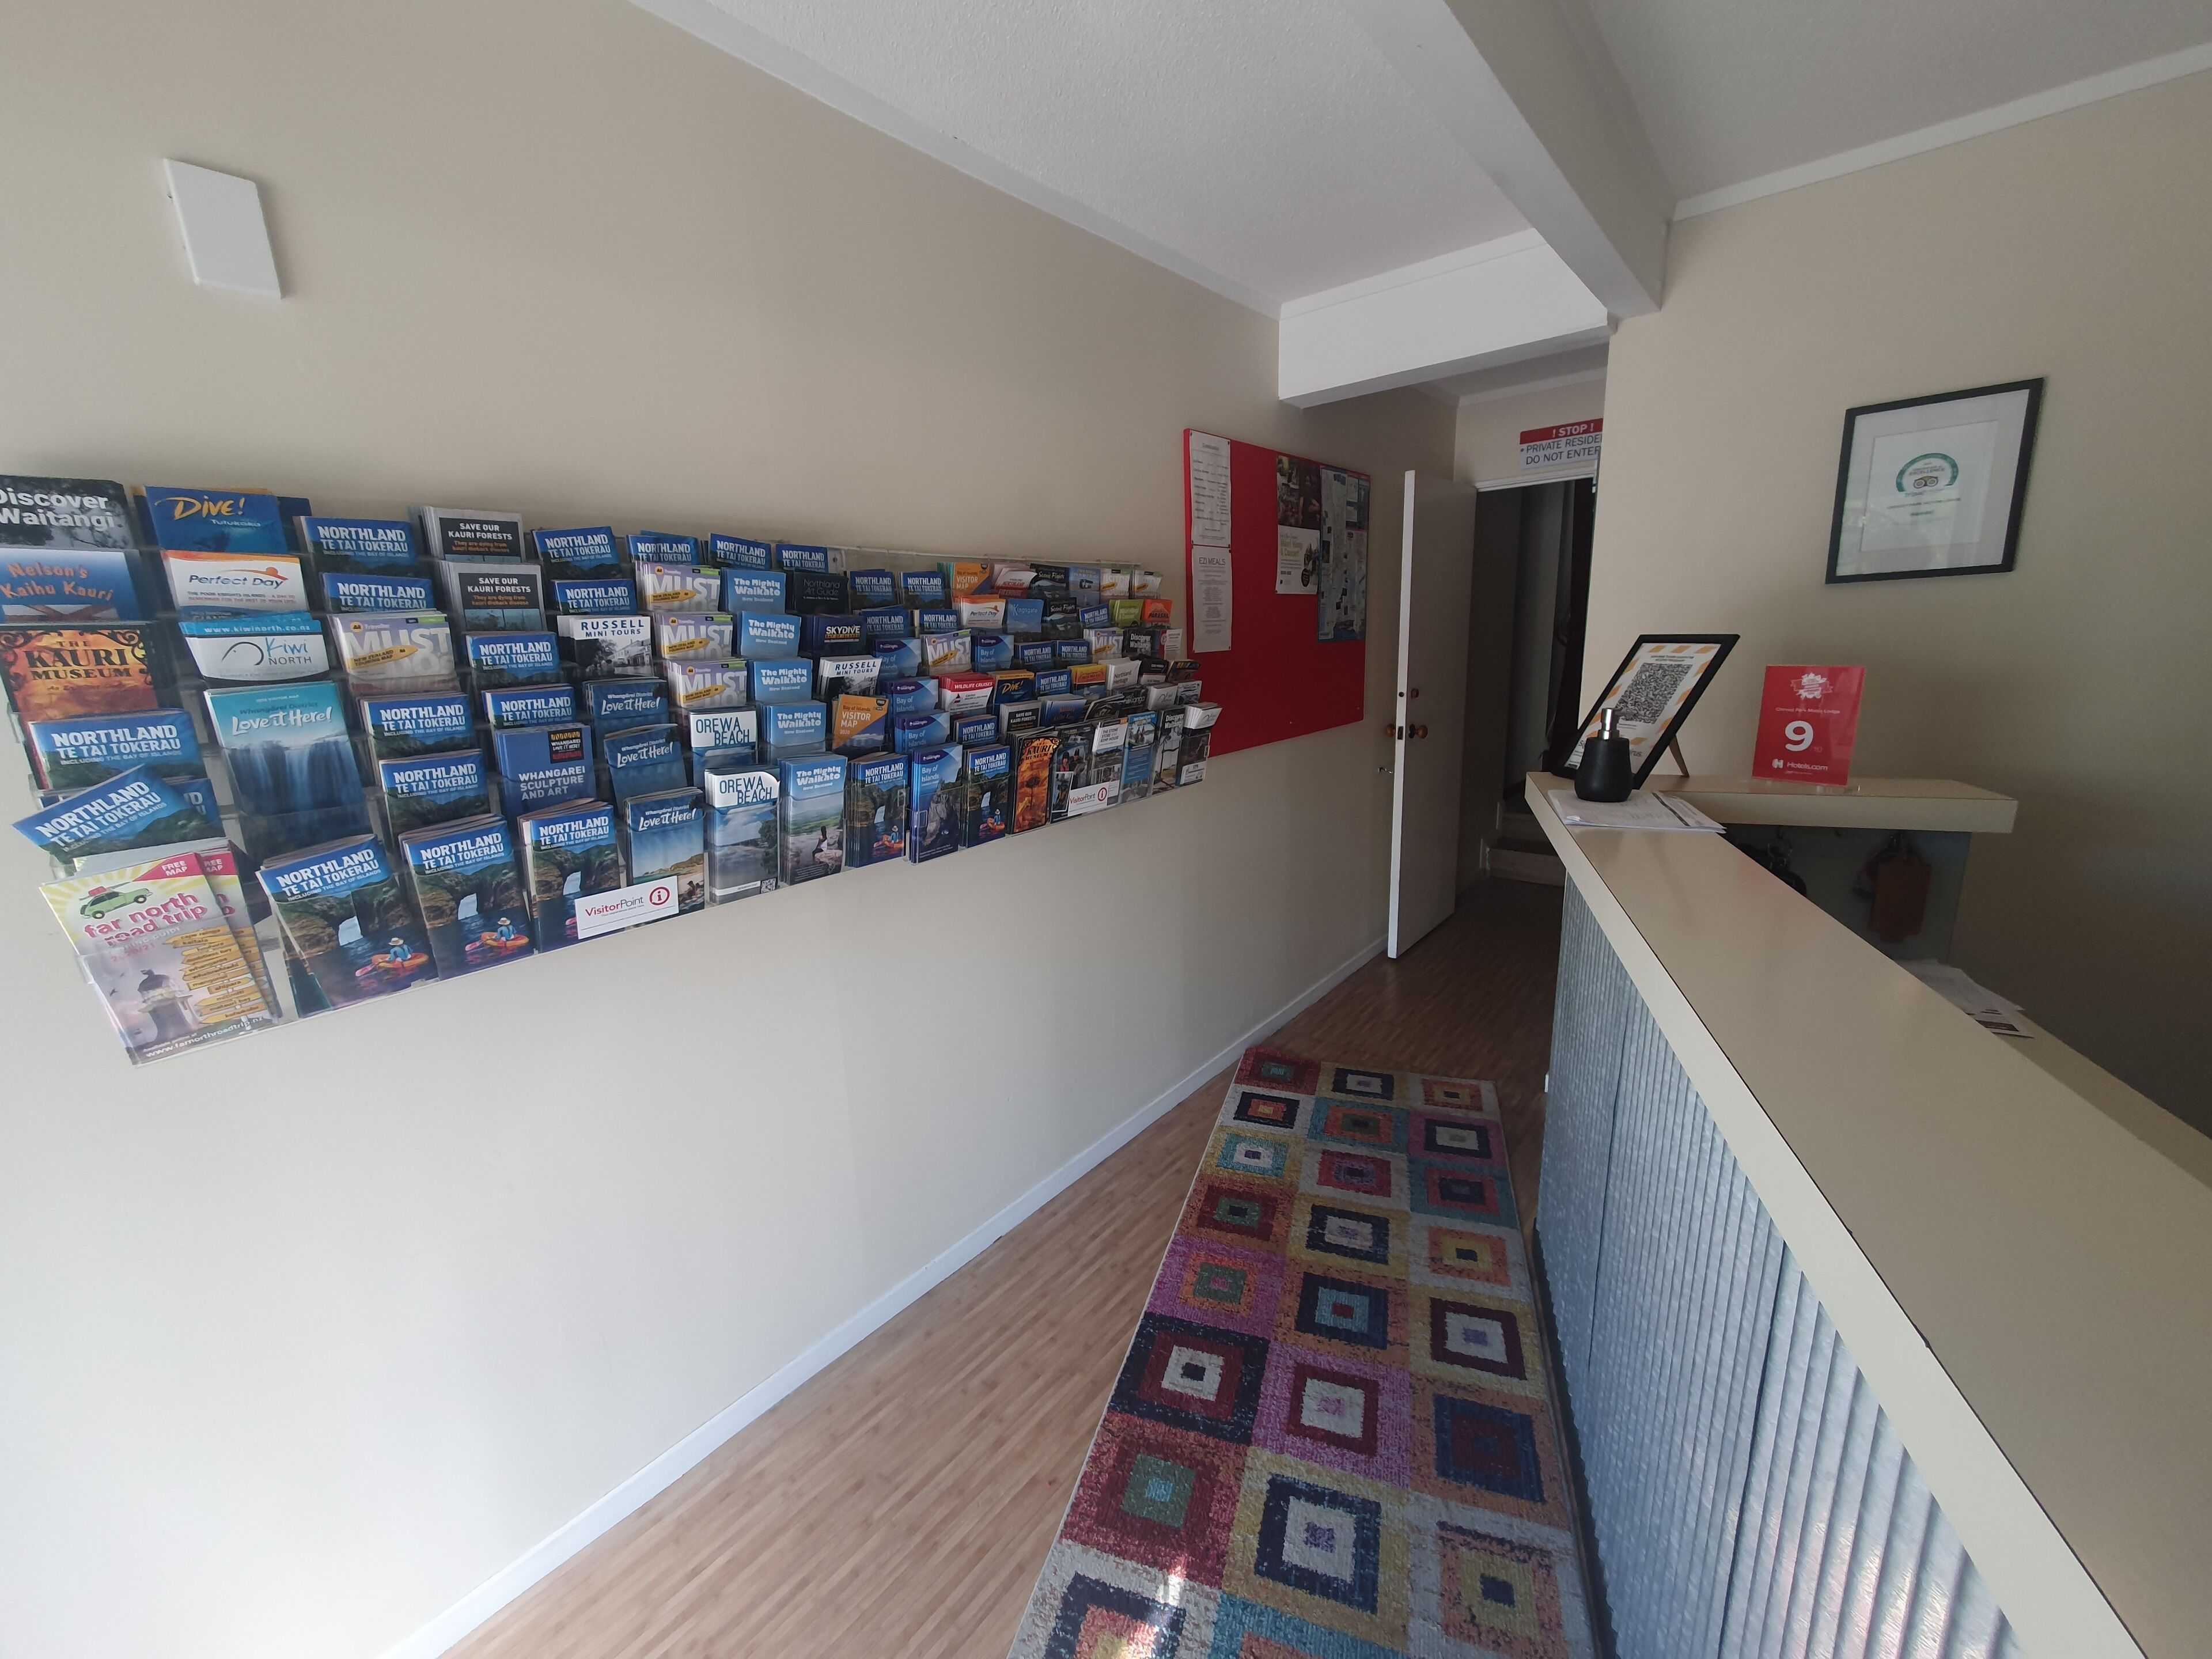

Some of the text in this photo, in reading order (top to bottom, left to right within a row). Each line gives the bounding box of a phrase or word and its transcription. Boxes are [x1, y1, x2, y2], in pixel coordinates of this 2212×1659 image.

[1558, 423, 1588, 437] STOP
[1526, 434, 1602, 454] PRIVATE RESIDE
[1526, 445, 1601, 465] DO NOT ENTER
[154, 495, 246, 521] Dive!
[0, 507, 115, 532] Waitangi
[459, 522, 500, 532] SAVE OUR
[317, 525, 407, 542] NORTHLAND
[448, 531, 513, 540] KAURI FORESTS
[320, 539, 408, 552] TE TAI TOKERAU
[544, 534, 608, 549] NORTHLAND
[1199, 556, 1226, 566] EZI MEALS
[7, 561, 89, 579] Nelson's
[189, 574, 284, 589] Perfect Day
[650, 574, 720, 600] MUST
[733, 577, 781, 589] The Mighty
[803, 578, 840, 589] Northland
[956, 575, 979, 584] VISITOR
[956, 582, 969, 590] MAP
[1, 580, 114, 601] Kaihu Kauri
[337, 582, 426, 600] NORTHLAND
[565, 586, 628, 600] NORTHLAND
[734, 585, 781, 597] Waikato
[804, 588, 839, 596] Art Guide
[339, 596, 427, 609] TE TAI TOKERAU
[1013, 604, 1039, 616] Kingsgate
[581, 619, 644, 631] RUSSELL
[748, 619, 795, 632] The Mighty
[825, 624, 861, 634] SKYDIVE
[663, 624, 733, 646] MUST
[749, 627, 795, 639] Waikato
[265, 637, 308, 657] Kiwi
[346, 627, 451, 657] MUST
[479, 642, 551, 656] NORTHLAND
[24, 649, 130, 668] KAURI
[268, 656, 312, 665] NORTH
[835, 661, 877, 671] RUSSELL
[30, 668, 132, 680] MUSEUM
[761, 676, 808, 685] Waikato
[778, 668, 807, 678] Mighty
[681, 671, 747, 695] MUST
[501, 696, 571, 712] NORTHLAND
[601, 696, 661, 715] Love it Here!
[896, 697, 907, 705] Bay
[379, 704, 464, 721] NORTHLAND
[794, 711, 821, 721] Mighty
[842, 711, 872, 721] VISITOR
[232, 706, 333, 736] Love it Here!
[382, 716, 466, 732] TE TAI TOKERAU
[696, 717, 741, 733] OREWA
[778, 718, 821, 729] Waikato
[840, 719, 858, 728] MAP
[51, 724, 179, 747] NORTHLAND
[714, 729, 749, 745] BEACH
[1785, 720, 1815, 752] 9
[56, 737, 181, 759] TE TAI TOKERAU
[617, 741, 674, 768] Love it Here!
[1027, 744, 1051, 755] KAURI
[1024, 752, 1048, 761] MUSEUM
[393, 763, 476, 784] NORTHLAND
[518, 766, 586, 782] WHANGAREI
[813, 766, 842, 776] Mighty
[922, 767, 932, 775] Bay
[1787, 762, 1828, 771] Hotels.com
[395, 774, 478, 794] TE TAI TOKERAU
[520, 775, 584, 791] SCULPTURE
[719, 775, 764, 794] OREWA
[796, 773, 841, 786] Waikato
[922, 773, 940, 782] Islands
[521, 786, 569, 801] AND ART
[737, 787, 772, 804] BEACH
[1070, 792, 1096, 804] VisitorPoint
[35, 781, 150, 838] NORTHLAND
[51, 791, 162, 847] TE TAI TOKERAU
[539, 816, 609, 837] NORTHLAND
[638, 808, 697, 832] Love it Here!
[420, 832, 502, 861] NORTHLAND
[422, 842, 504, 870] TE TAI TOKERAU
[162, 860, 187, 870] FREE
[165, 866, 188, 876] MAP
[276, 849, 375, 888] NORTHLAND
[282, 859, 380, 897] TE TAI TOKERAU
[585, 896, 644, 917] VisitorPoint
[84, 892, 199, 938] far north
[104, 905, 207, 948] road trip
